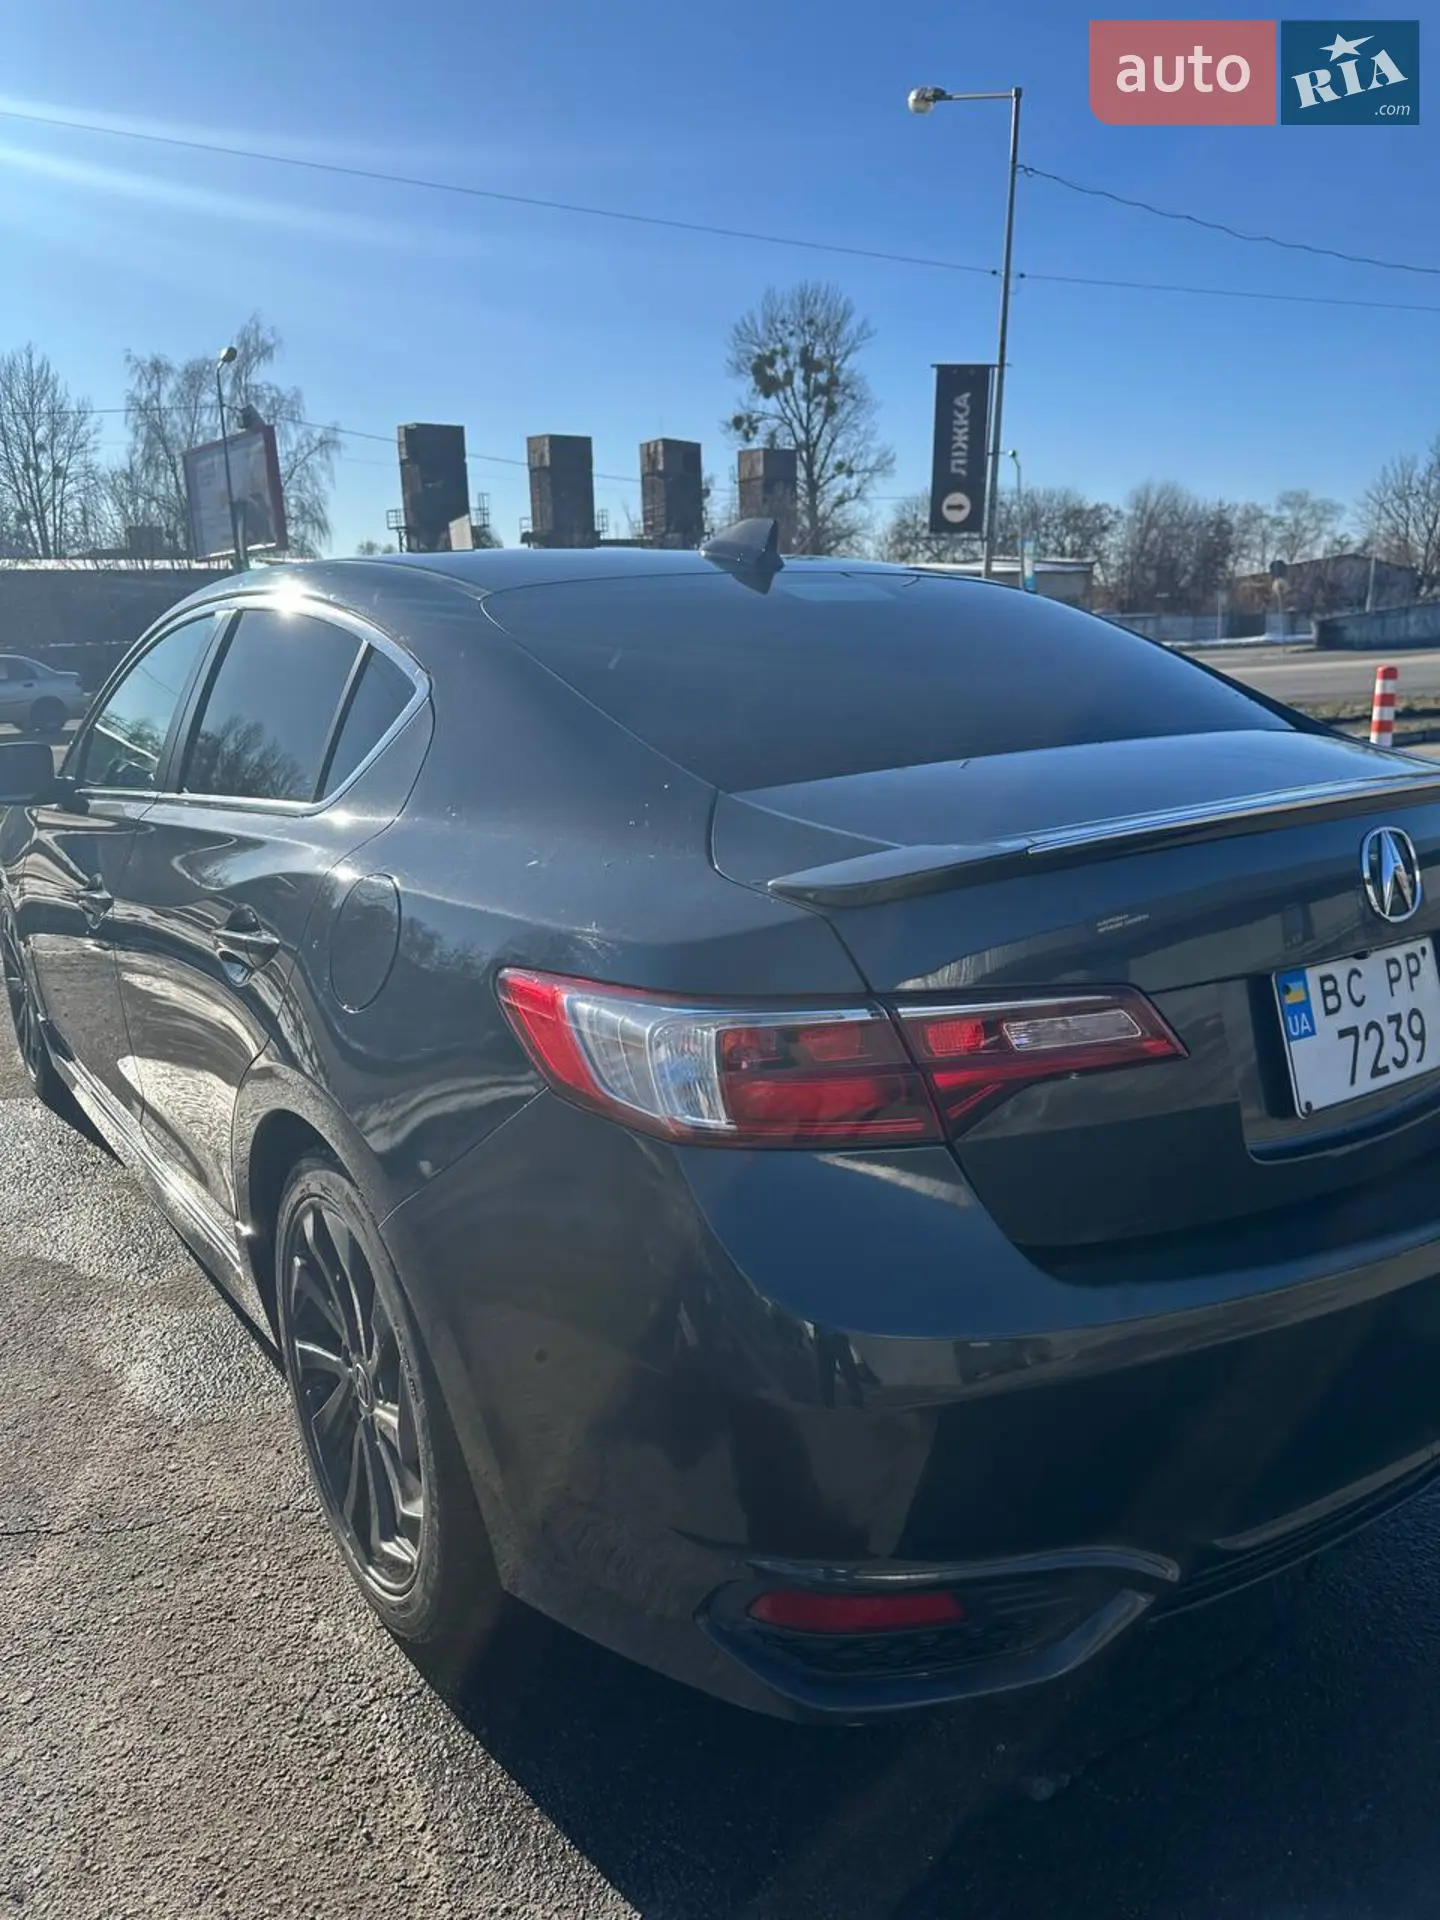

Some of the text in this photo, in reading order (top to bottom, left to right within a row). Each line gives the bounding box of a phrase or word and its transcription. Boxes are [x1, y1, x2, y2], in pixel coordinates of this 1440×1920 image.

[950, 392, 971, 476] ЛІЖКА
[1319, 951, 1421, 1016] BC PP
[1288, 1013, 1312, 1036] UA
[1337, 1007, 1427, 1087] 7239
